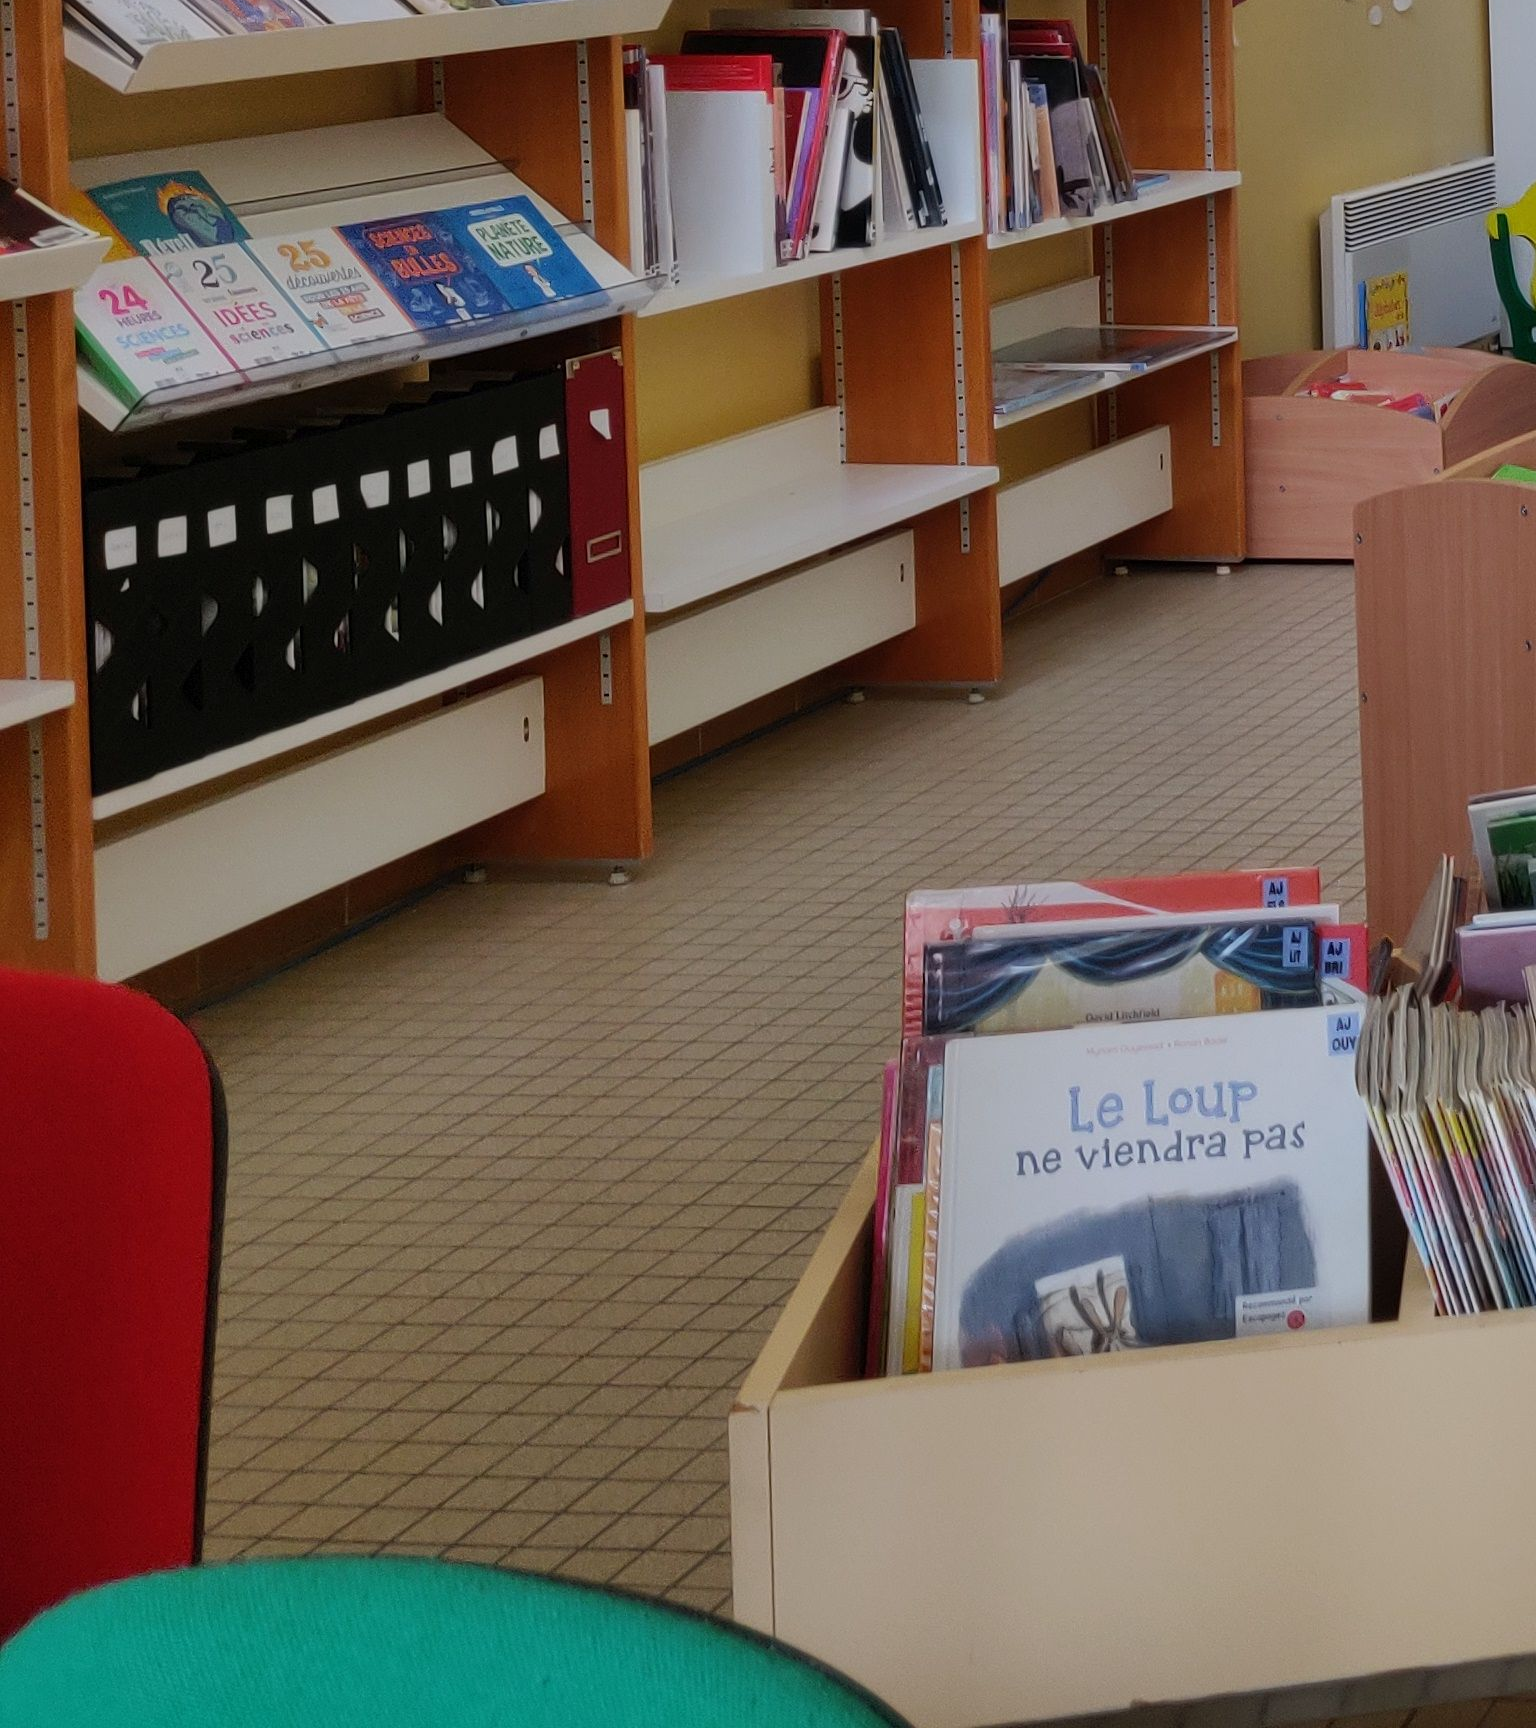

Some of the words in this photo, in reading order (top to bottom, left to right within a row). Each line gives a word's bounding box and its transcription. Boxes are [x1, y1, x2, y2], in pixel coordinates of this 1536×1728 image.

[277, 240, 331, 272] 25
[488, 235, 549, 261] NATURE
[193, 253, 238, 289] 25
[286, 266, 362, 290] découvertes
[391, 252, 460, 280] BULLES
[98, 285, 150, 316] 24
[116, 310, 163, 328] HEURES
[213, 300, 278, 328] IDÉES
[116, 323, 191, 349] SCIENCES
[229, 323, 295, 345] sciences
[1267, 880, 1284, 897] AJ
[1326, 941, 1344, 958] AJ
[1324, 958, 1344, 975] BRI
[1085, 1011, 1113, 1023] David
[1115, 1008, 1161, 1022] Litchfield
[1336, 1016, 1352, 1031] AJ
[1331, 1036, 1358, 1052] OUY
[1068, 1084, 1125, 1134] Le
[1142, 1078, 1259, 1130] Loup
[1015, 1144, 1062, 1177] ne
[1075, 1129, 1227, 1171] viendra
[1243, 1119, 1306, 1161] pas
